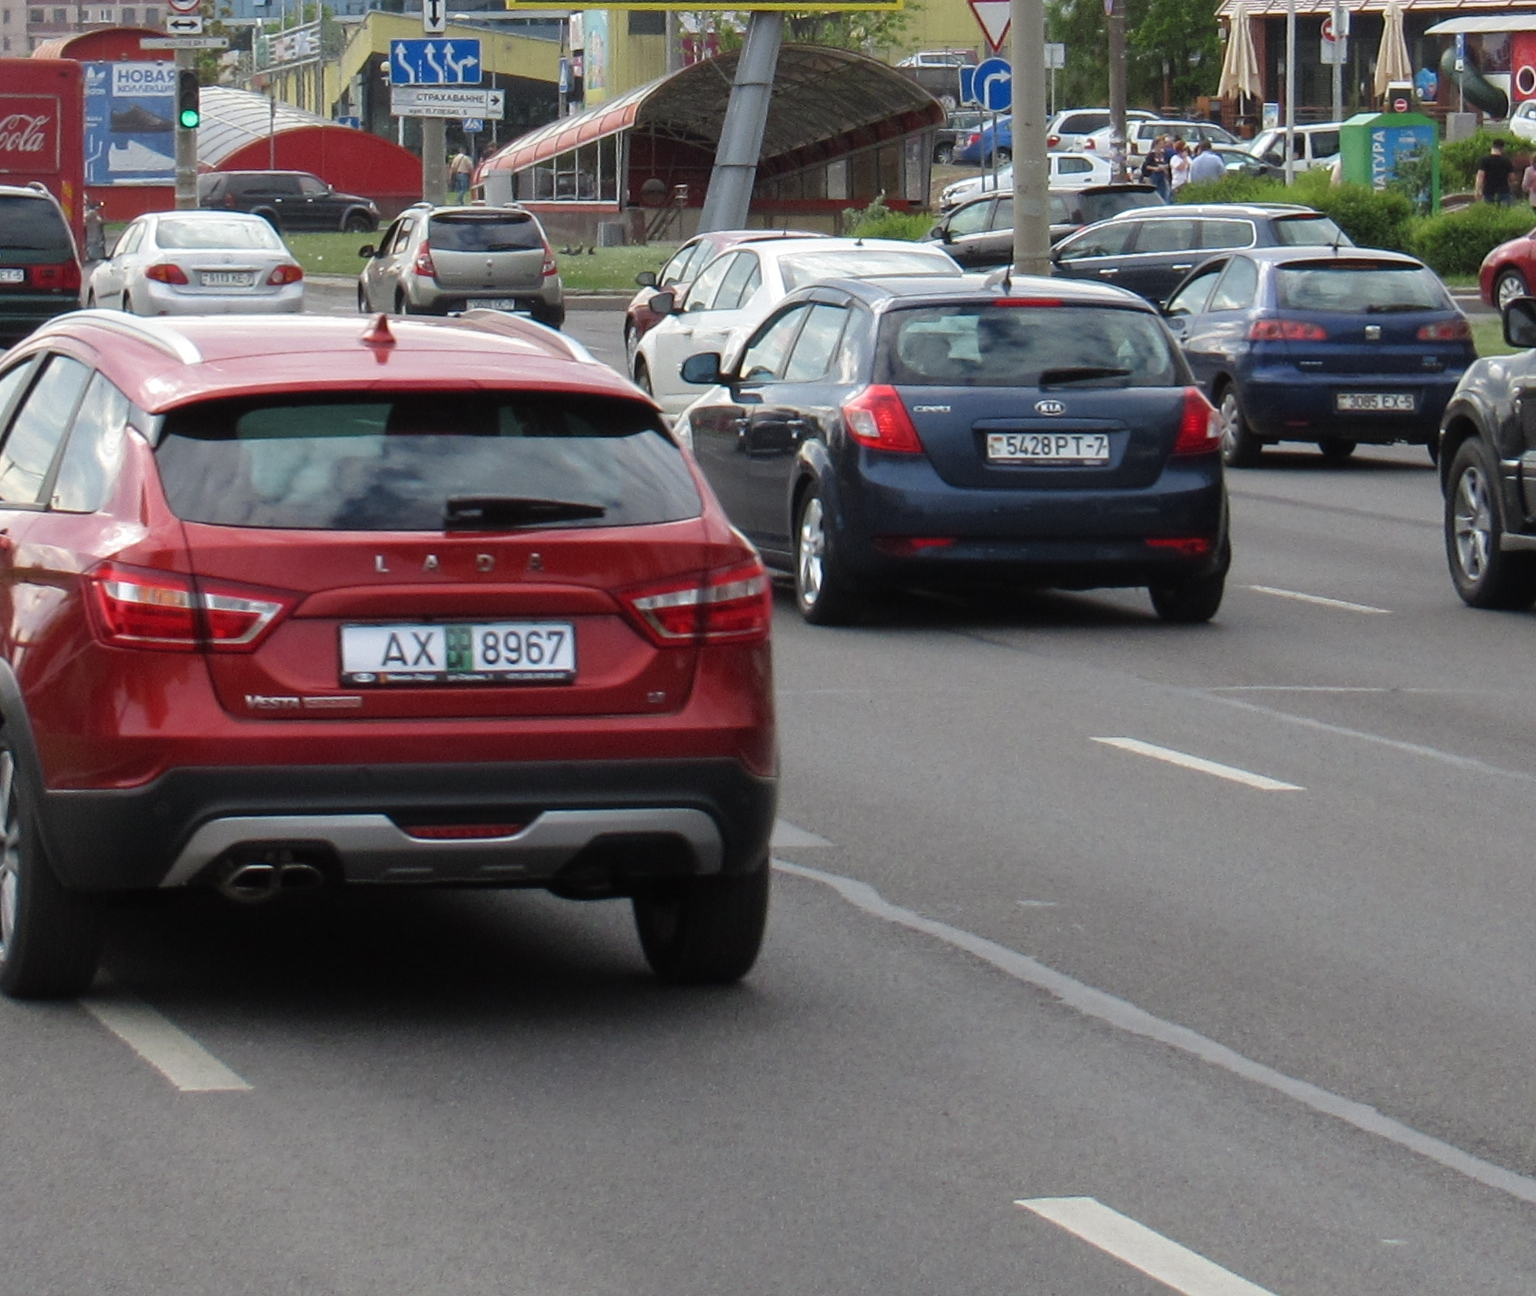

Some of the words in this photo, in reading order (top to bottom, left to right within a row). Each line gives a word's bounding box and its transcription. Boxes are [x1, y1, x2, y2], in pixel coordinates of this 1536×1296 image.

[117, 70, 176, 83] НОВАЯ
[1040, 403, 1062, 413] KIA
[381, 631, 436, 666] AX
[481, 630, 565, 665] 8967
